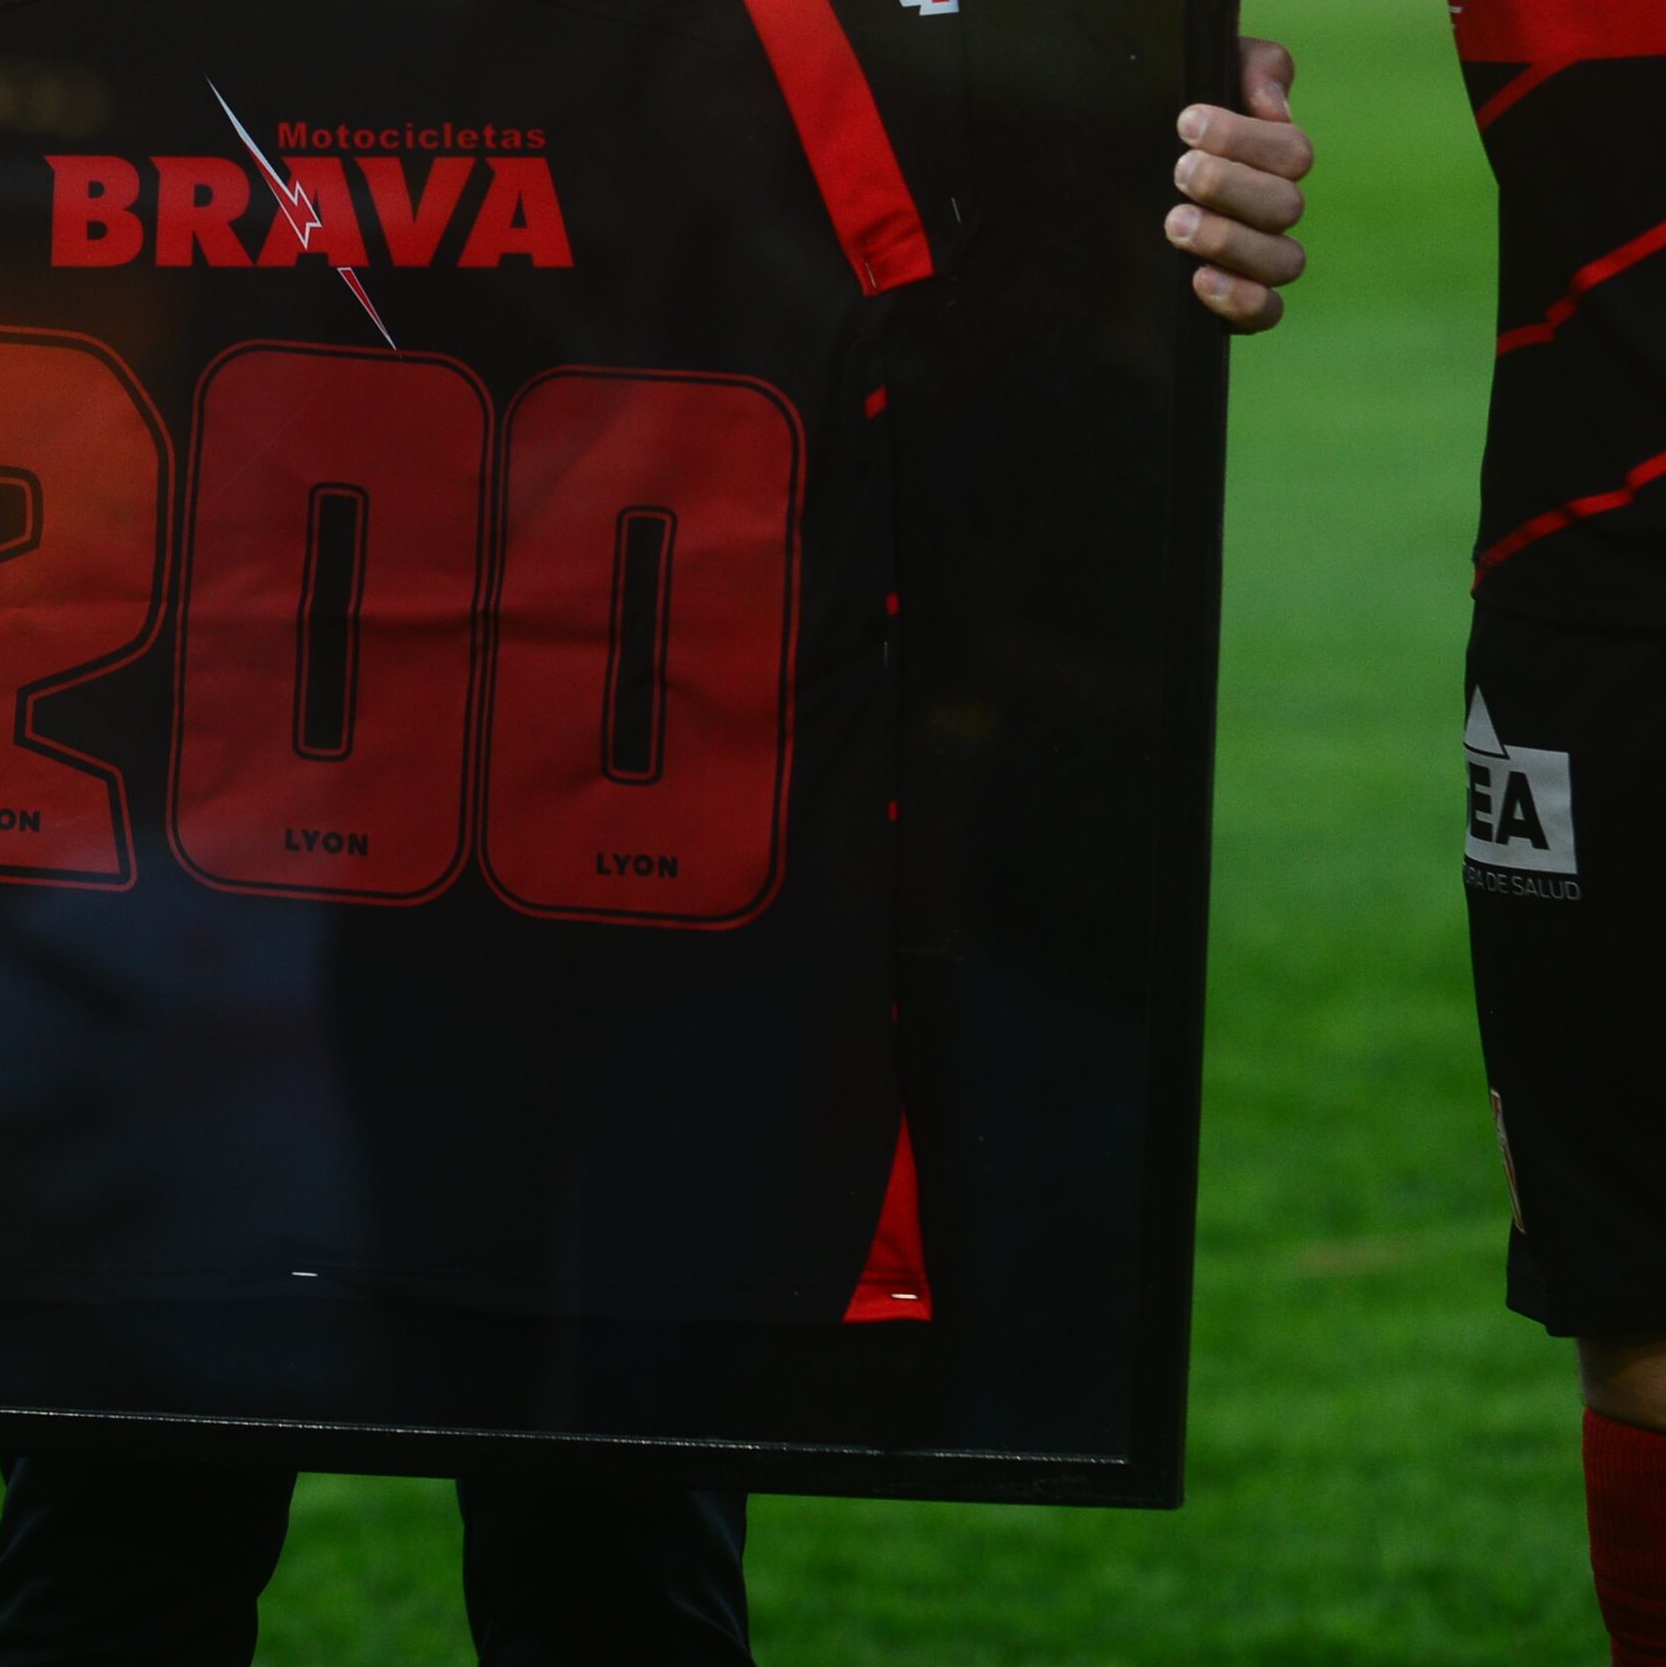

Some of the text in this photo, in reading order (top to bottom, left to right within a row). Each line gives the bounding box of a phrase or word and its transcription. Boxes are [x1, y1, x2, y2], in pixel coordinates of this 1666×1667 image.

[277, 121, 548, 150] Motocicletas
[44, 155, 575, 268] BRAVA
[284, 827, 369, 857] LYON
[595, 852, 679, 879] LYON
[1486, 872, 1508, 894] DE
[1510, 875, 1582, 901] SALUD
